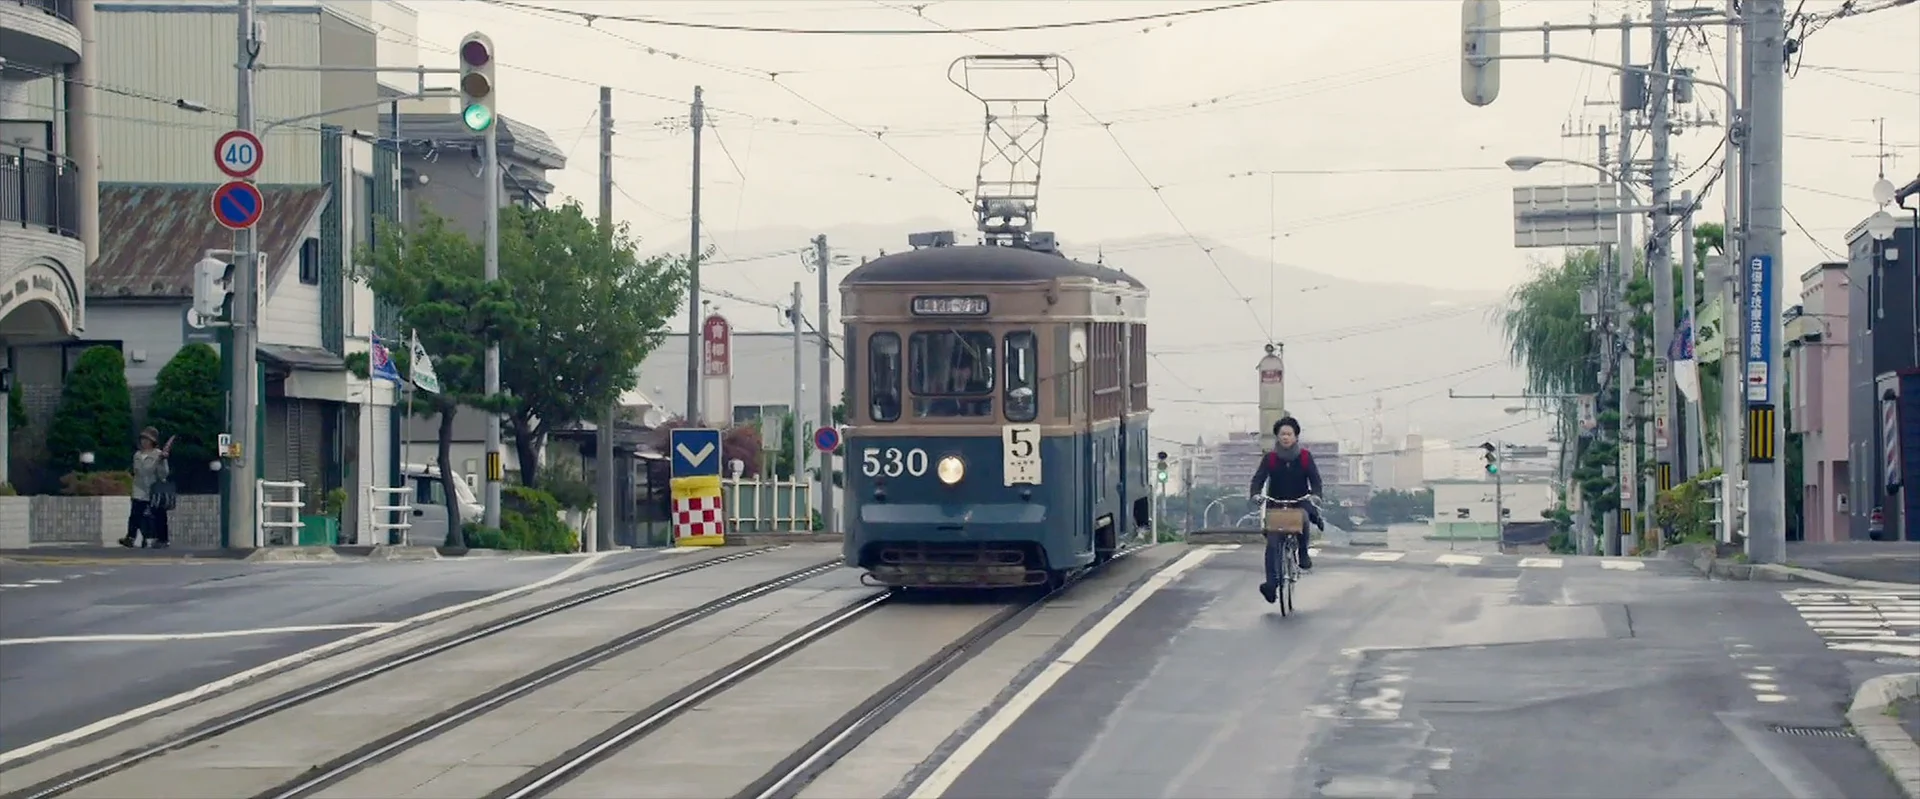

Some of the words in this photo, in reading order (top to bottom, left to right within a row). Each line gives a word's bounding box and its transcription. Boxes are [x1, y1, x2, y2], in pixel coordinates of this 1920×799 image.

[225, 144, 253, 165] 40
[1011, 428, 1033, 458] 5
[862, 448, 929, 478] 530
